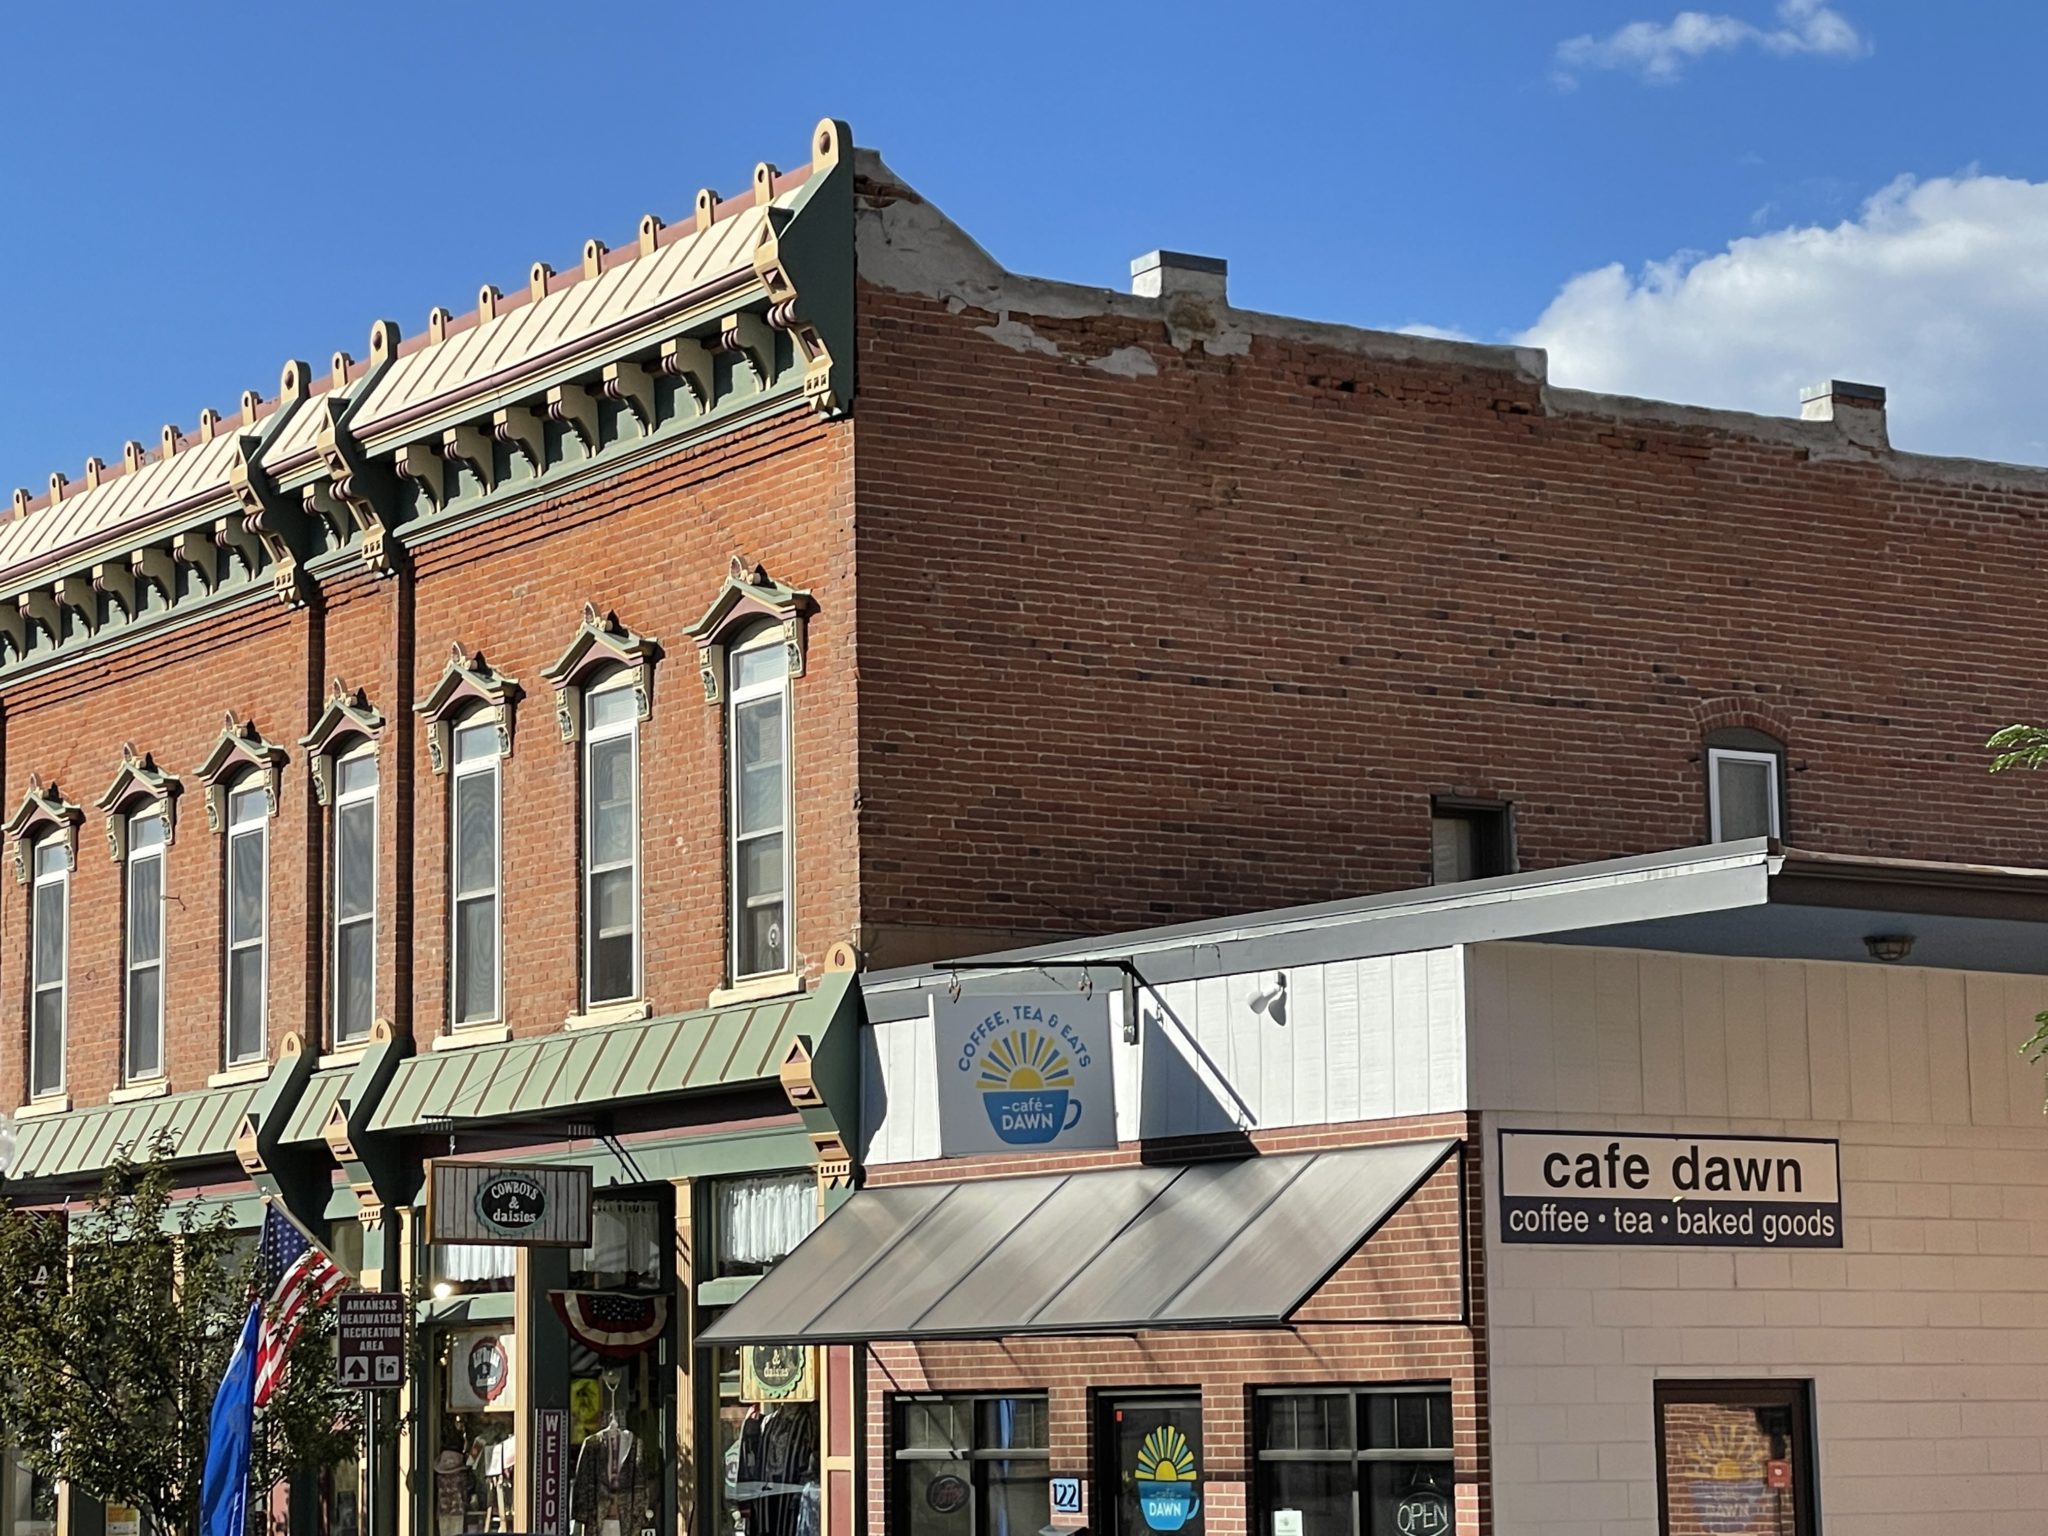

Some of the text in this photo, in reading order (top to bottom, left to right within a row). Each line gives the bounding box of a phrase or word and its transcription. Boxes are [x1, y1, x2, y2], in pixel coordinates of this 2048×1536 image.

[958, 1005, 1091, 1072] COFFEE, TEA & EATS
[1002, 1113, 1053, 1130] DAWN
[1543, 1143, 1802, 1193] cafe dawn
[491, 1181, 539, 1200] COWBOYS
[508, 1195, 520, 1209] &
[492, 1208, 536, 1222] daisies
[1509, 1203, 1835, 1243] coffee tea baked goods
[346, 1300, 398, 1311] ARKANSAS
[340, 1313, 403, 1324] HEADWATERS
[343, 1327, 400, 1338] RECREATION
[359, 1340, 385, 1351] AREA
[1052, 1483, 1077, 1508] 122
[1150, 1502, 1182, 1516] DAWN
[1397, 1500, 1449, 1532] OPEN
